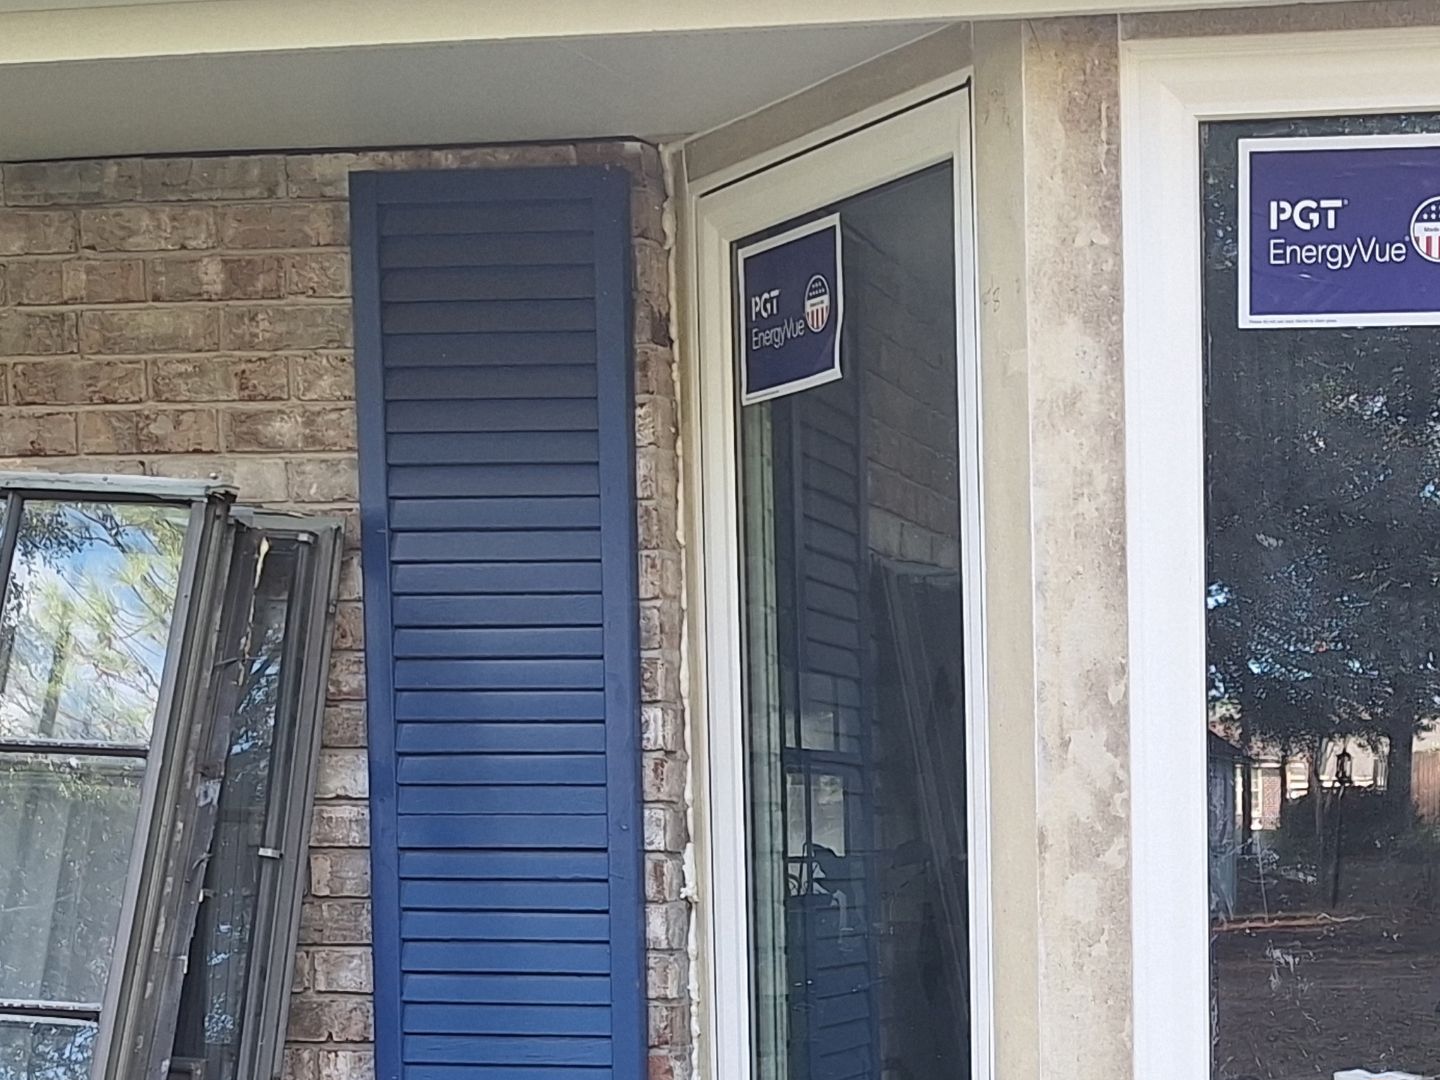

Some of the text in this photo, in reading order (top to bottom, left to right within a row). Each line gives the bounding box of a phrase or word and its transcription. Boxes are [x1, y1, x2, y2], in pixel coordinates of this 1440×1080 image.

[1269, 199, 1343, 231] PGT
[1269, 237, 1407, 270] EnergyVue
[751, 289, 780, 322] PGT
[752, 317, 805, 350] EnergyVue
